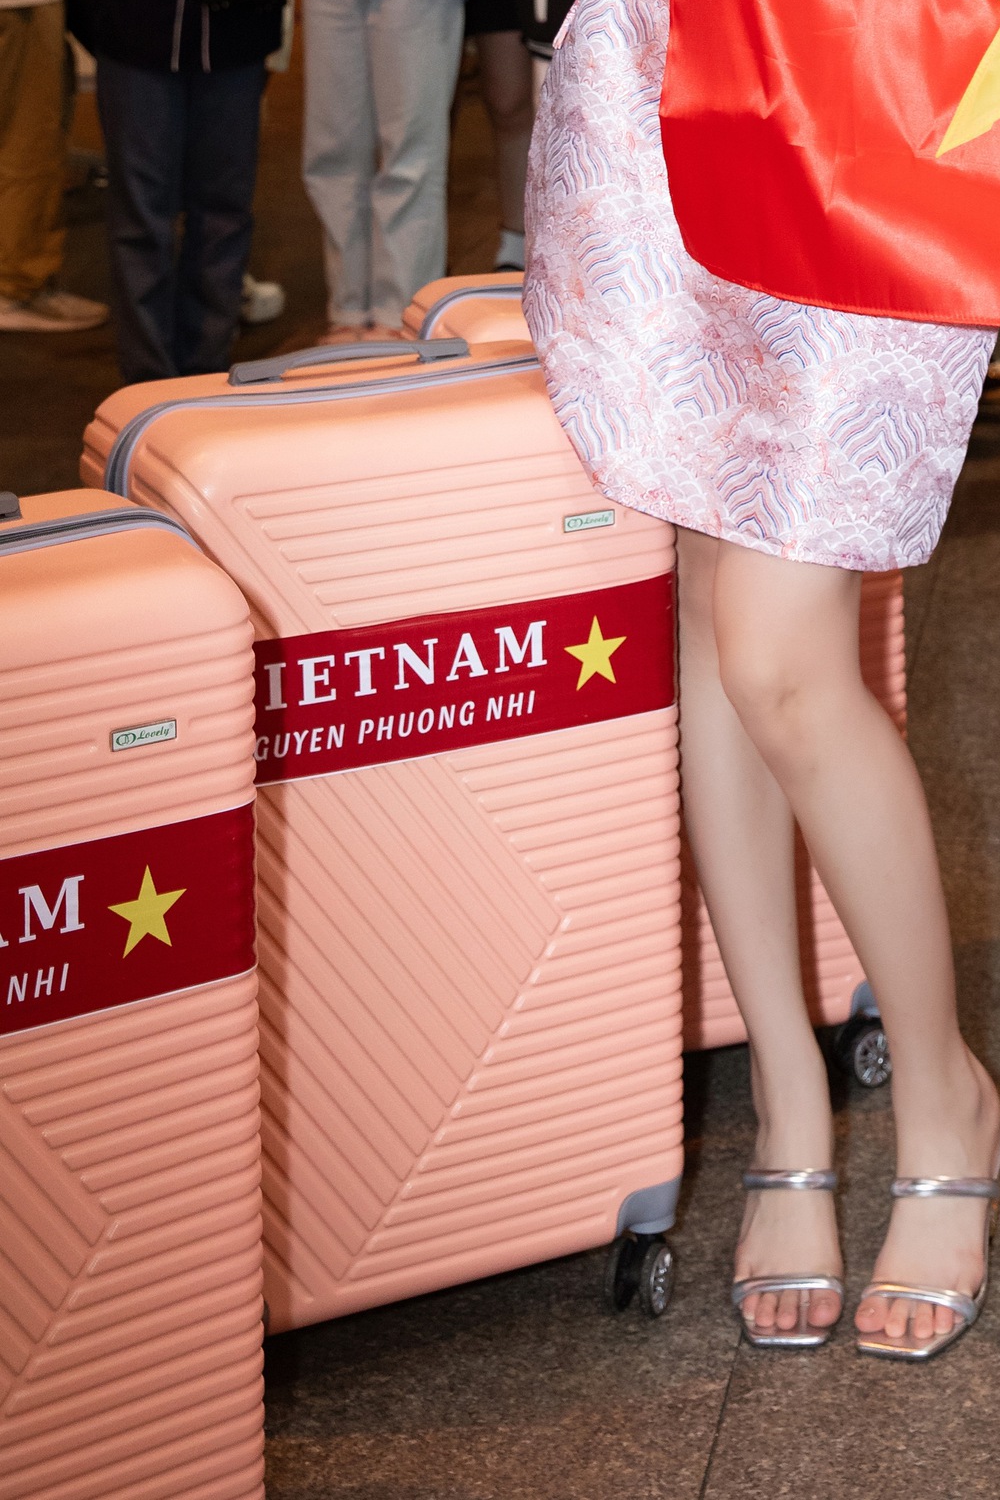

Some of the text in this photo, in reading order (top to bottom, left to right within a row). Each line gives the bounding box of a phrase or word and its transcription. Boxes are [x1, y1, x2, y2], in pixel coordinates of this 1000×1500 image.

[263, 620, 547, 711] IETNAM
[137, 726, 170, 740] Lovely
[254, 690, 535, 761] GUYEN PHUONG NHI
[0, 874, 85, 948] M
[6, 962, 70, 1006] NHI
